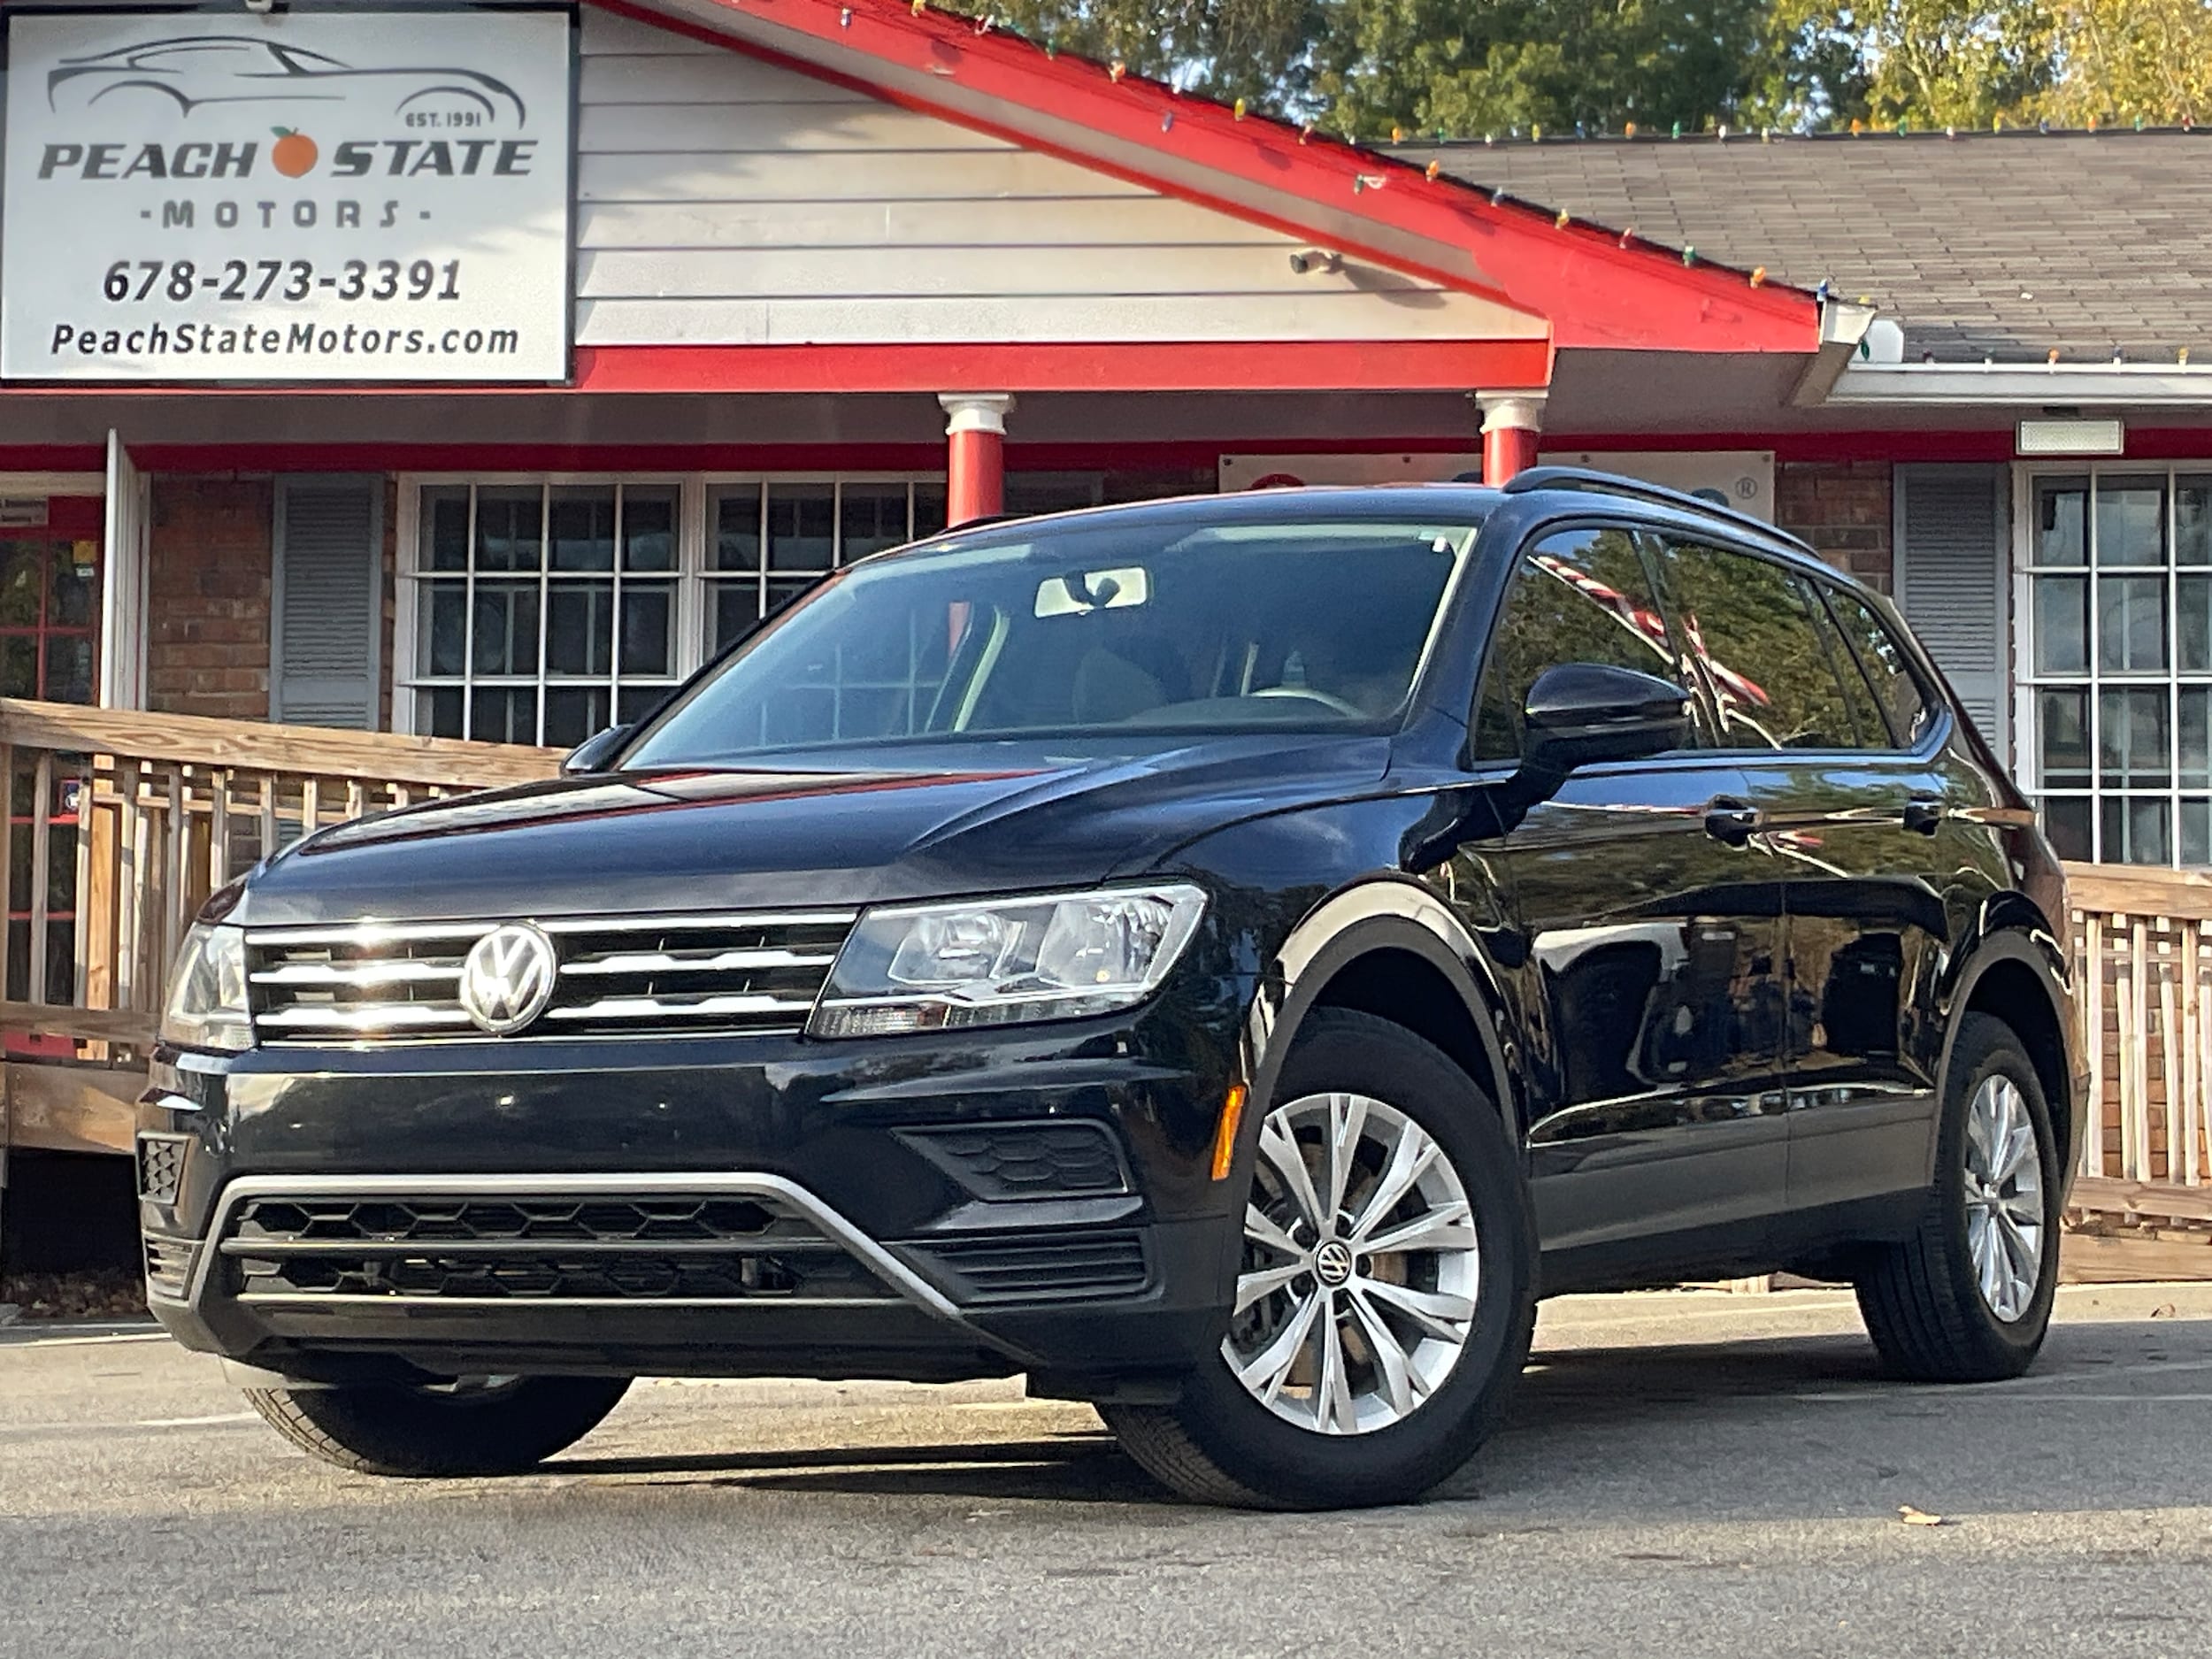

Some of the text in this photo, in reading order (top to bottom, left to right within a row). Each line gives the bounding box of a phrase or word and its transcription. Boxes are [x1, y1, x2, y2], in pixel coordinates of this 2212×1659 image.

[405, 111, 481, 127] EST. 1991
[37, 139, 539, 180] PEACH STATE
[103, 259, 461, 302] 678-273-3391
[51, 322, 519, 355] PeachStateMotors.com
